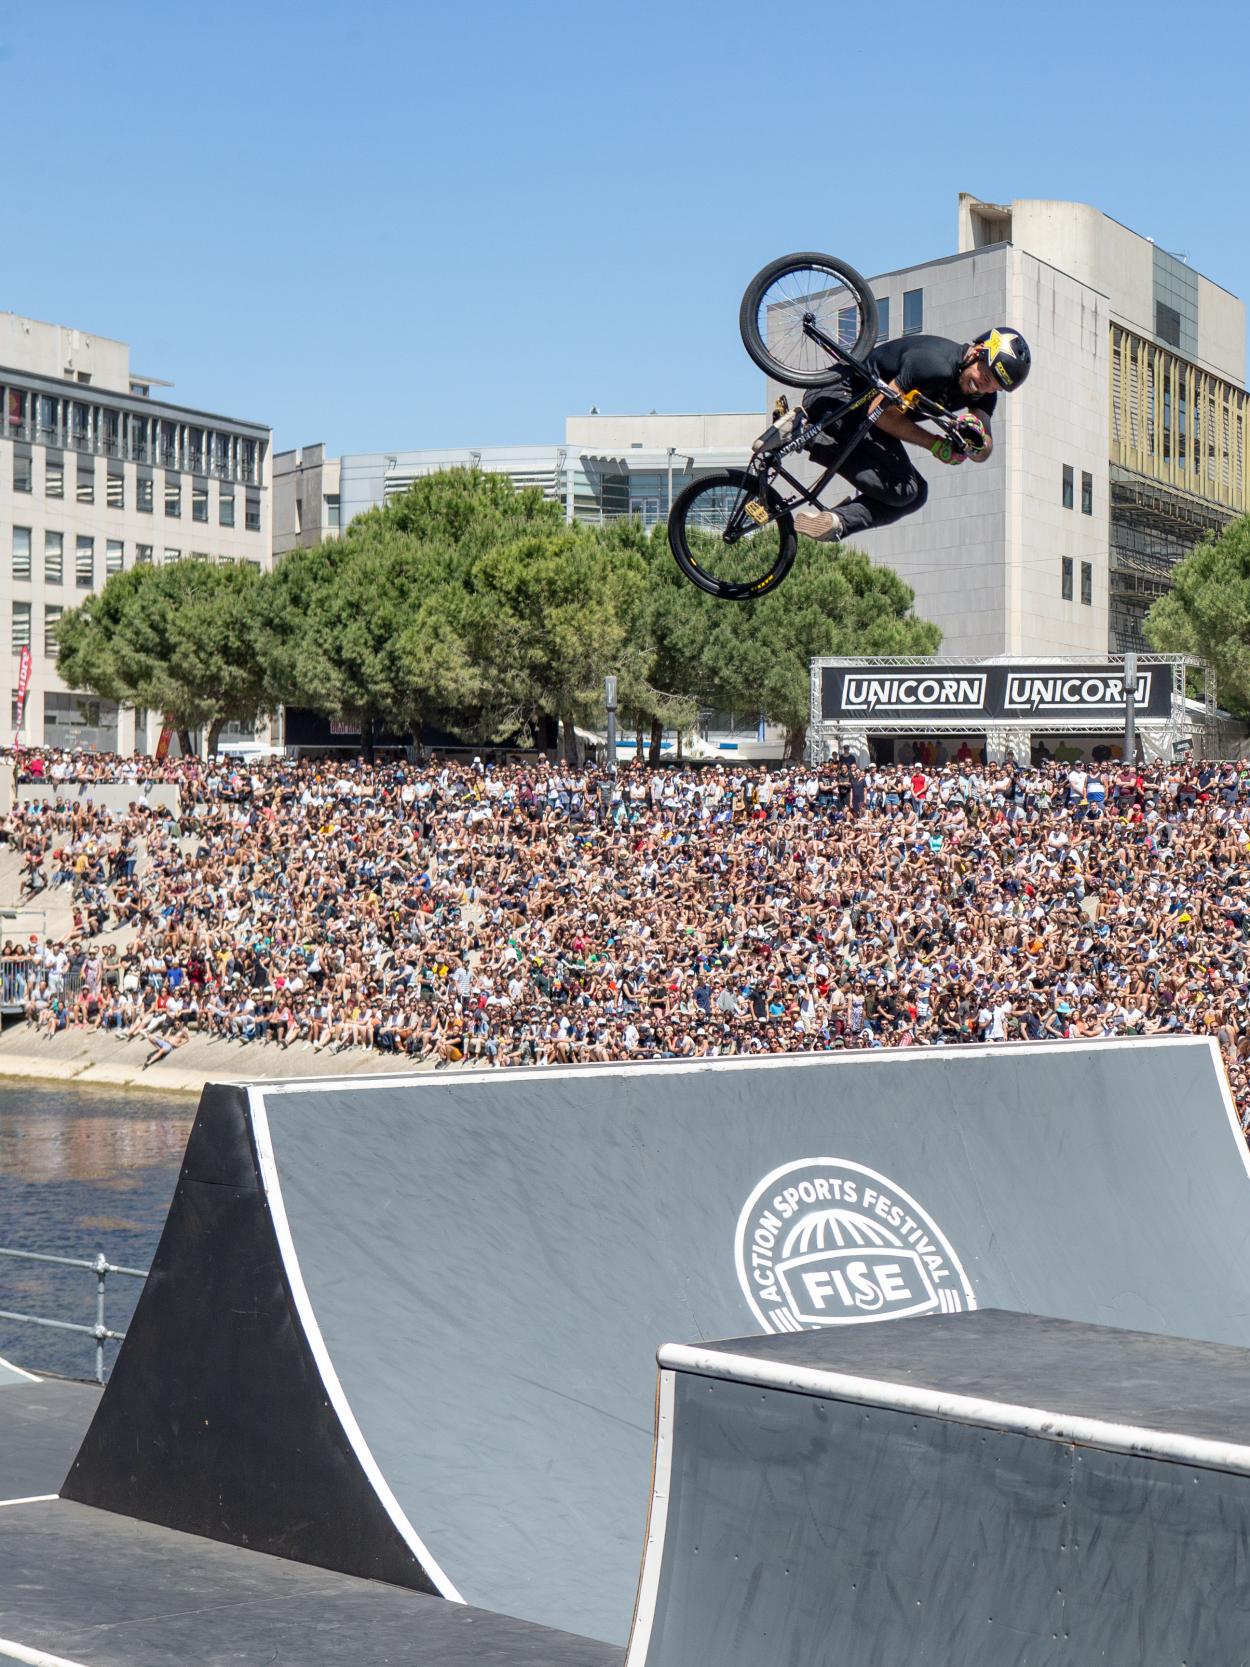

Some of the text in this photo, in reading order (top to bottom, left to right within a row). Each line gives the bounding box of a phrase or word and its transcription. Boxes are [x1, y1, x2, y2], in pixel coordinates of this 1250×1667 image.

[848, 679, 981, 710] UNICORN
[752, 1178, 951, 1303] ACTION SPORTS FESTIVAL
[802, 1261, 913, 1311] FISE
